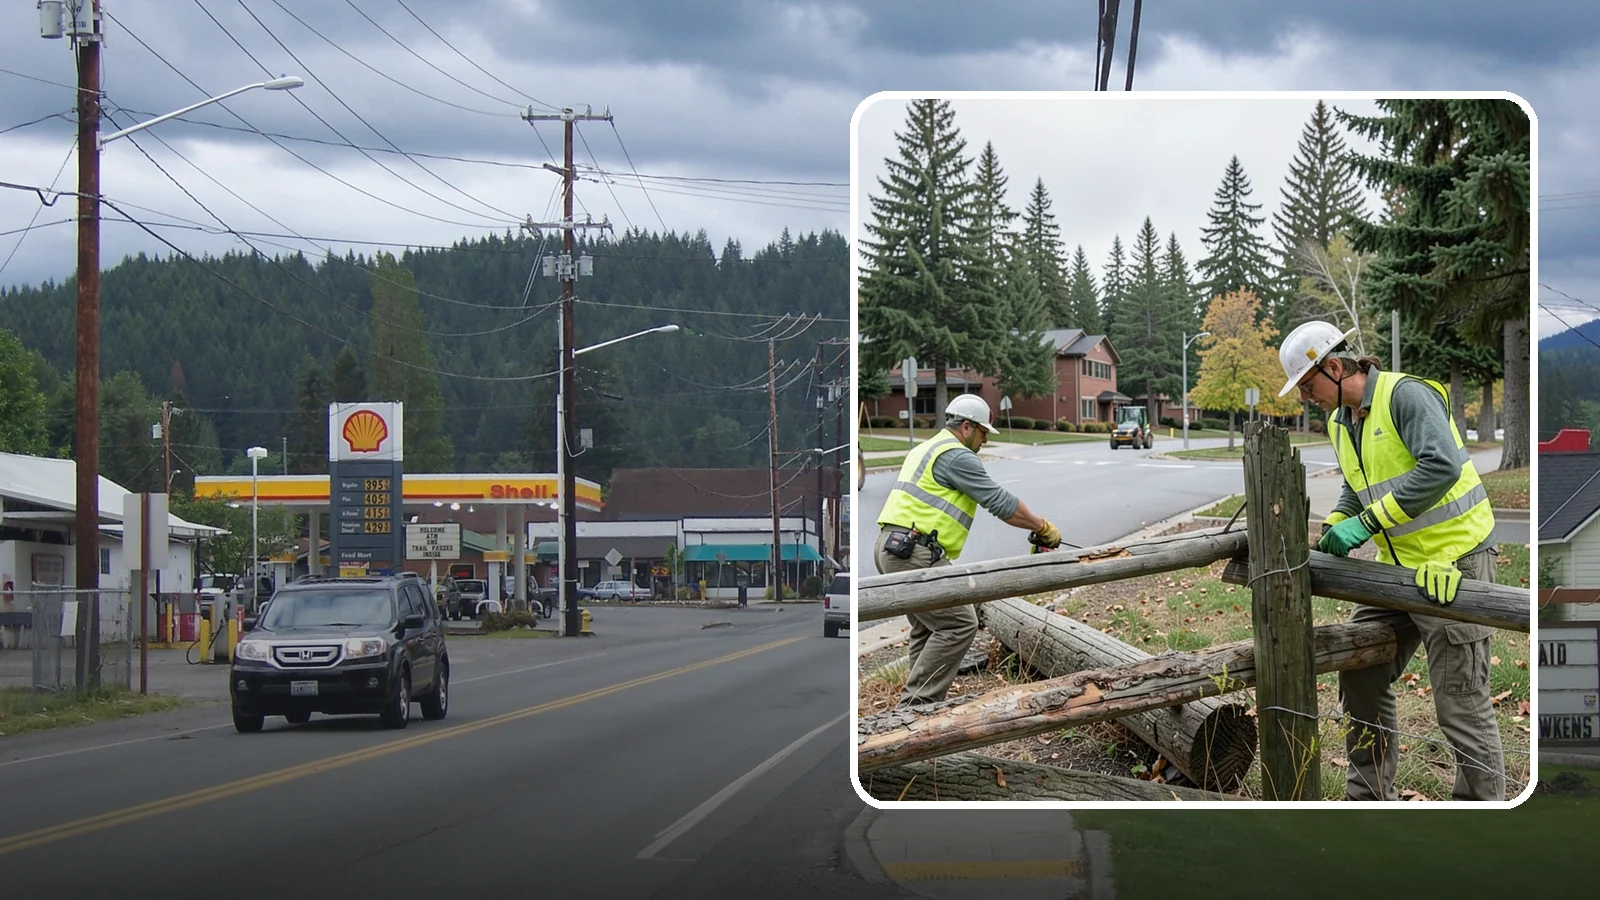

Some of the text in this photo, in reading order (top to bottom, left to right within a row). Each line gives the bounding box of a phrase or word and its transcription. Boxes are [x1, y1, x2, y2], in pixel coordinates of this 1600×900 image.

[366, 480, 383, 490] 395
[490, 484, 547, 499] Shell
[366, 494, 383, 504] 405
[366, 508, 383, 518] 415
[366, 522, 383, 532] 429
[1538, 643, 1566, 665] AID
